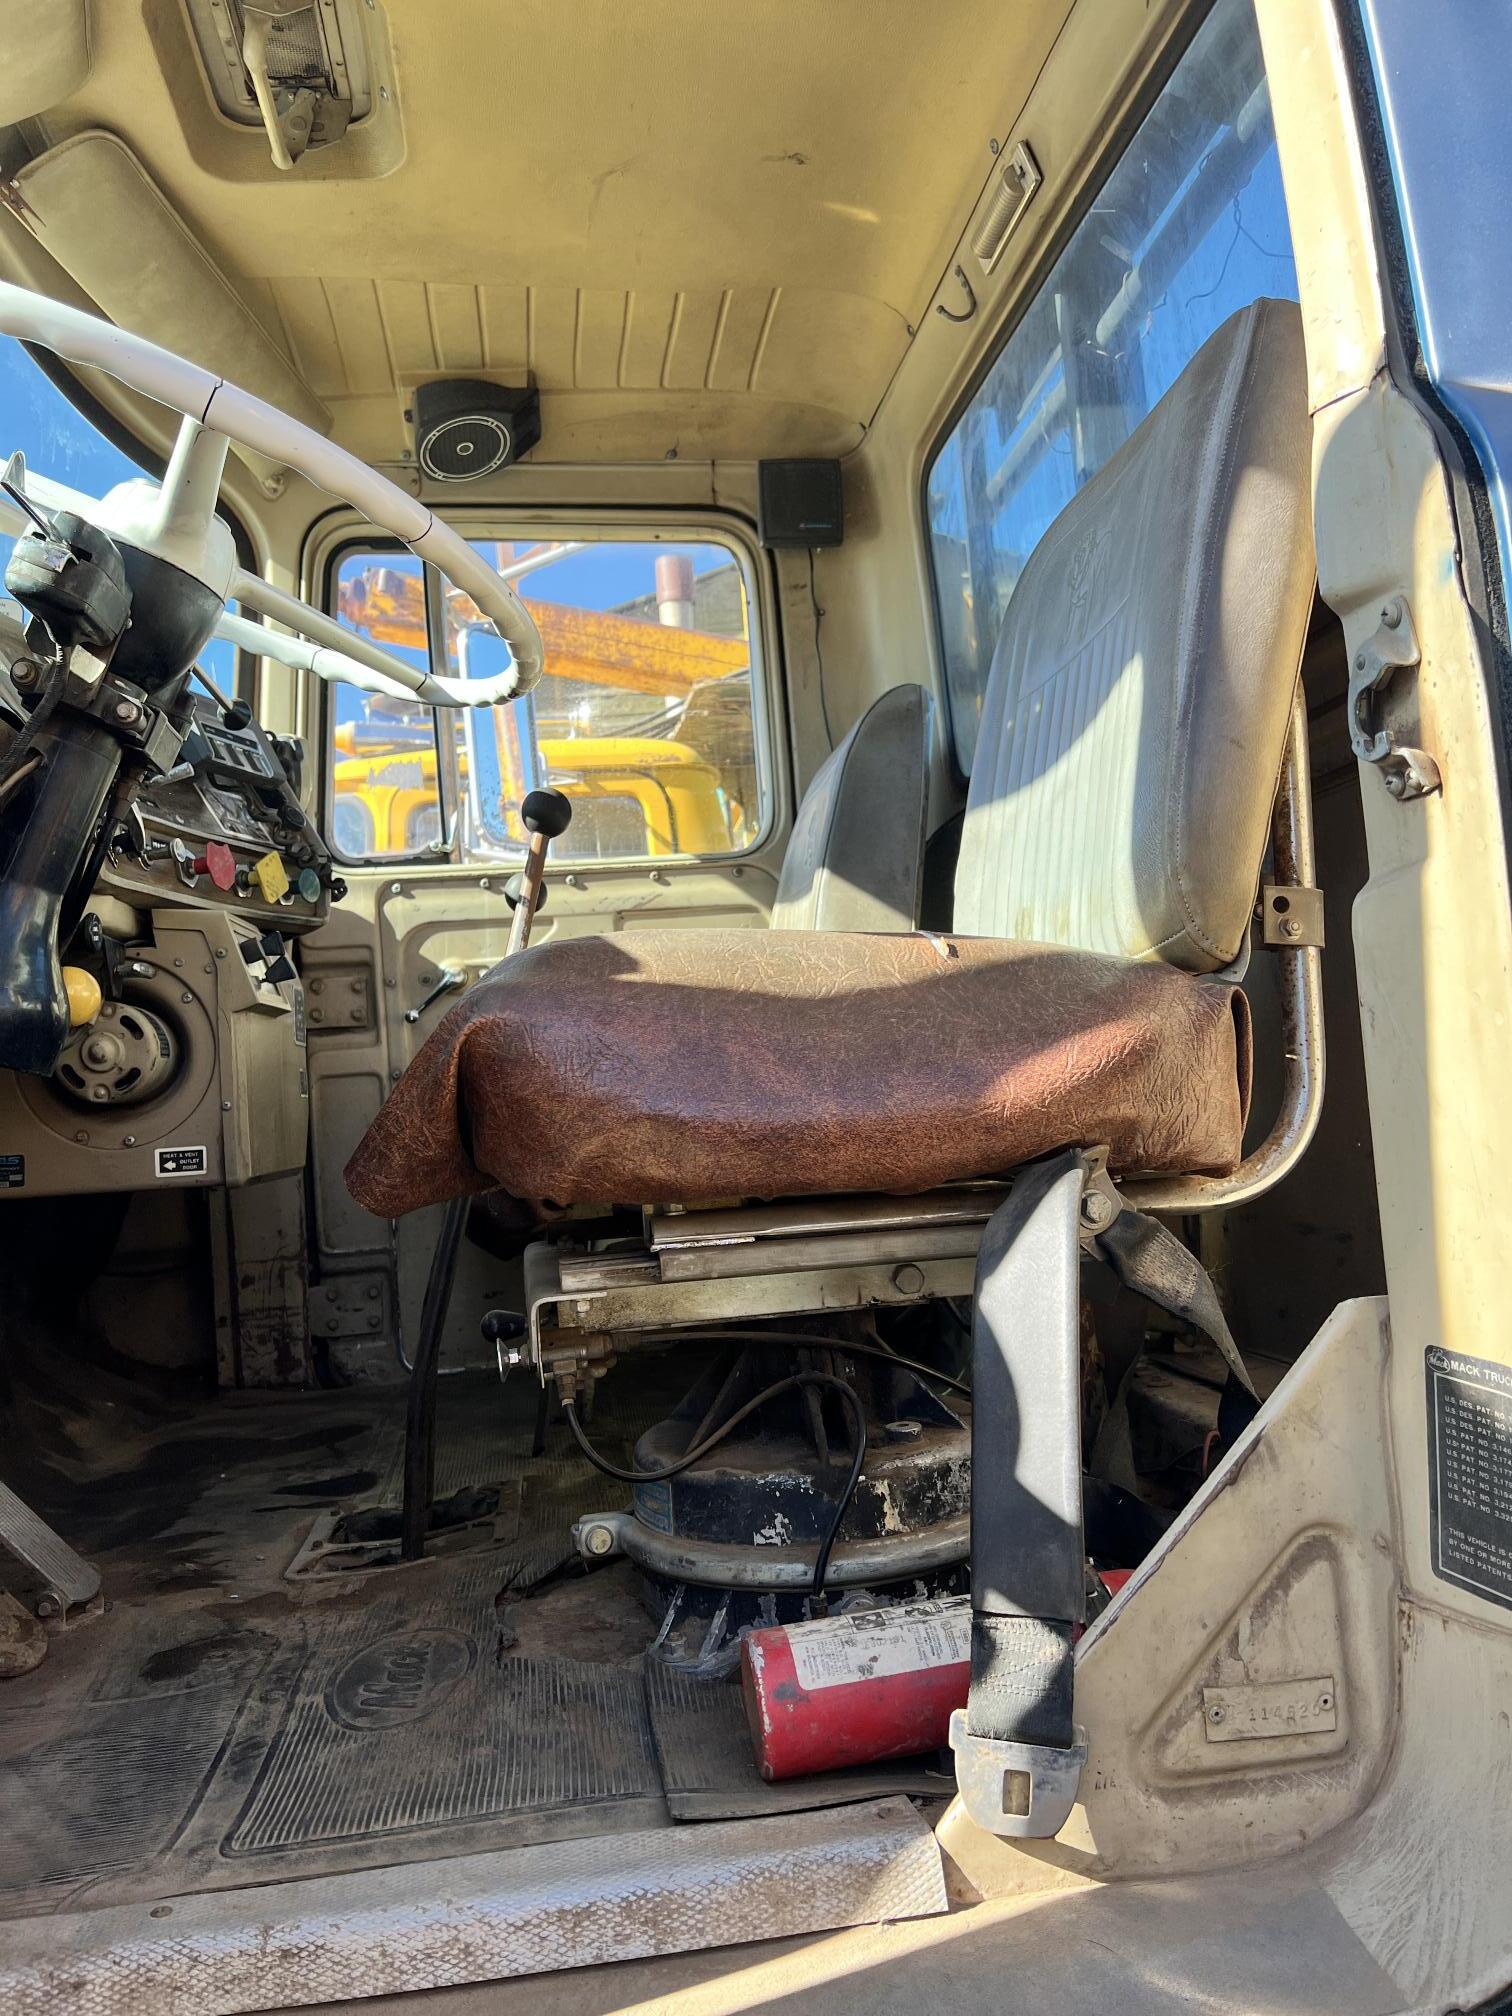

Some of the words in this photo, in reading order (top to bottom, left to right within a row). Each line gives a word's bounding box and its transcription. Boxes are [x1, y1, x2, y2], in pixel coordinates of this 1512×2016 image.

[1450, 1360, 1480, 1377] MACK
[1448, 1527, 1465, 1539] THIS
[1467, 1536, 1496, 1552] VEHICLE
[1498, 1548, 1507, 1556] IS
[1448, 1538, 1458, 1546] BY
[1460, 1543, 1475, 1554] ONE
[1477, 1550, 1488, 1559] OR
[1490, 1555, 1512, 1569] MORE
[1449, 1549, 1475, 1565] LISTED
